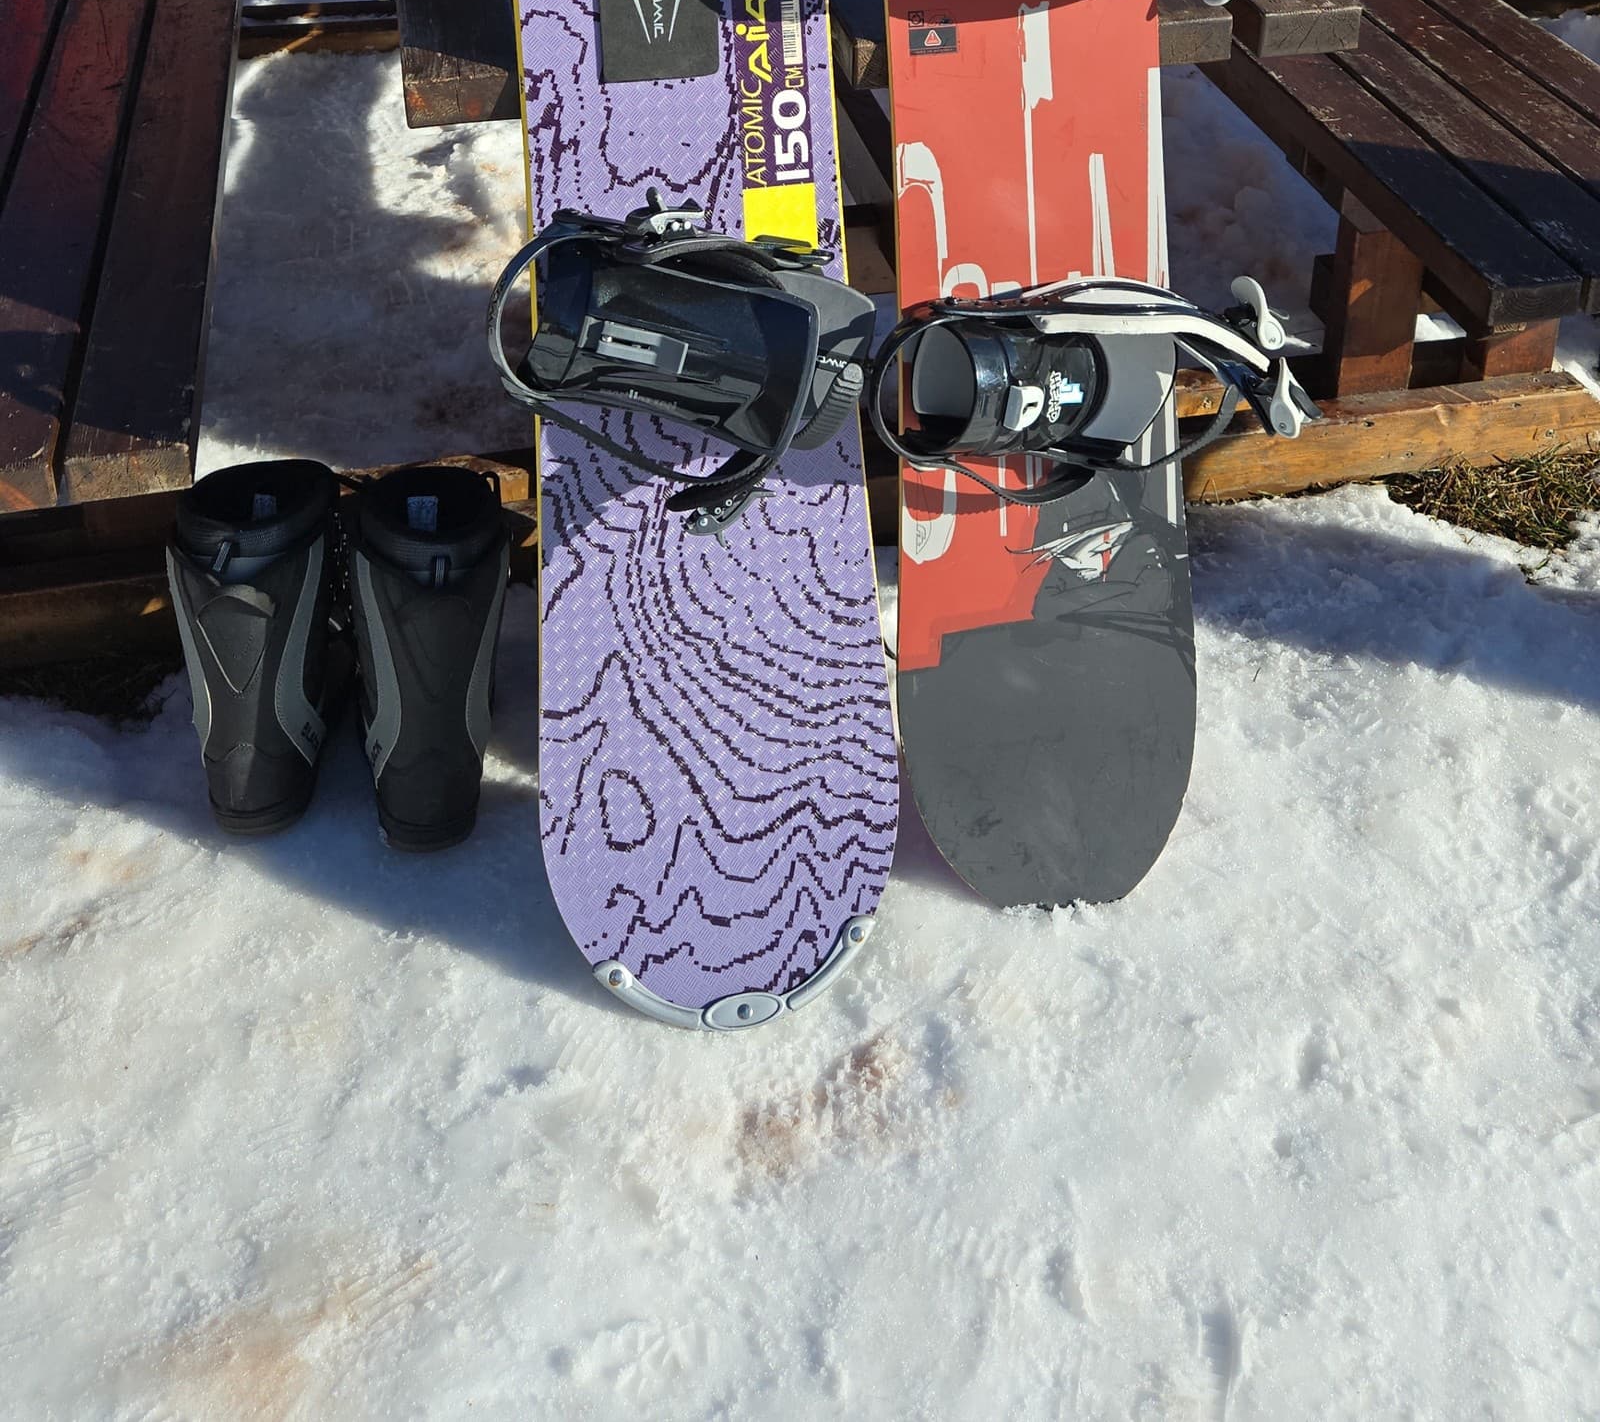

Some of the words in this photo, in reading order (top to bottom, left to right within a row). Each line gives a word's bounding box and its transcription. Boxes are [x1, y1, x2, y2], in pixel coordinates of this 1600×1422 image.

[785, 65, 804, 89] CM
[740, 79, 768, 187] ATOMIC
[771, 88, 811, 182] 150
